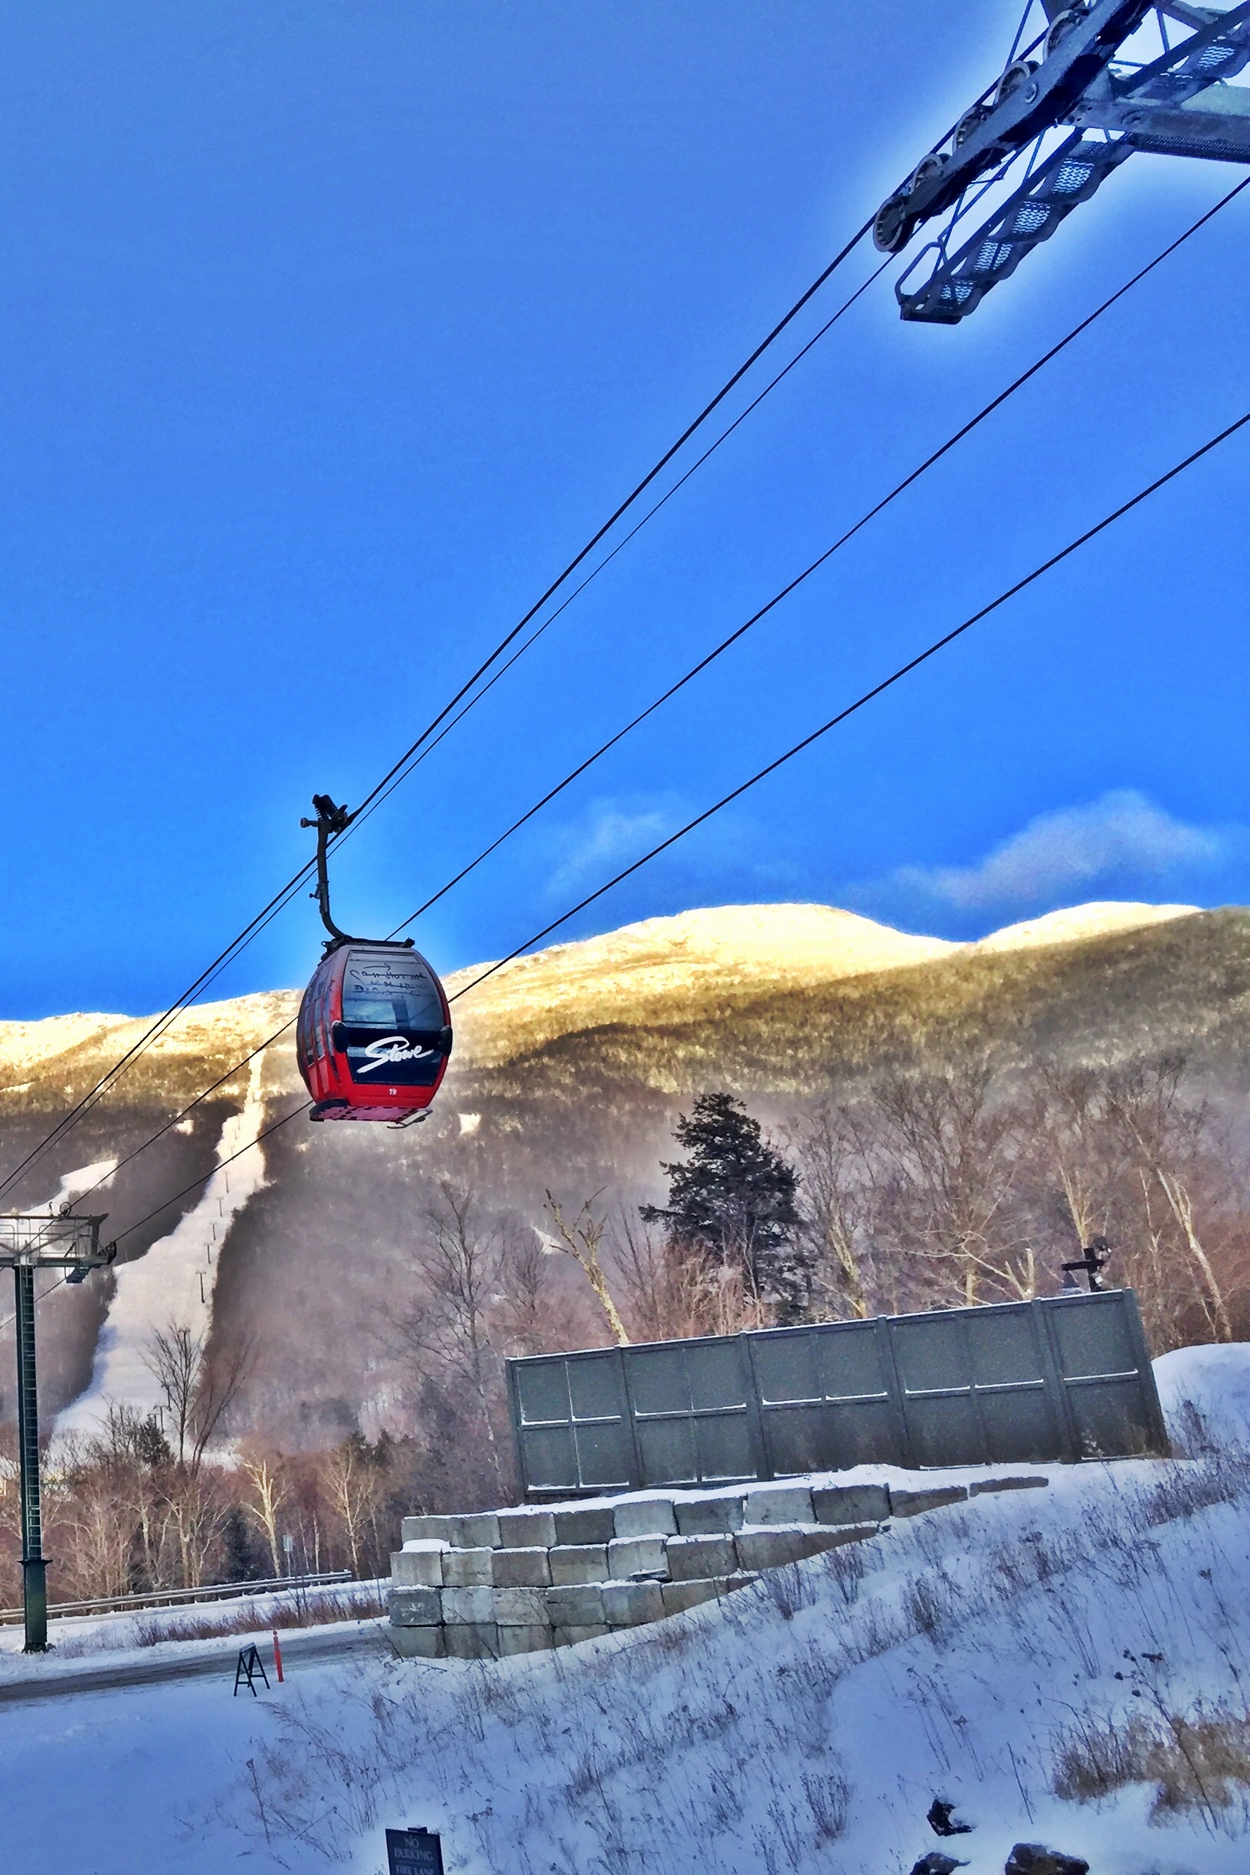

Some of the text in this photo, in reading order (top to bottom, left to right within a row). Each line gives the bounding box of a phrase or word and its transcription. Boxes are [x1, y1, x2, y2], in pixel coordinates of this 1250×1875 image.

[356, 1036, 434, 1073] Stowe
[404, 1835, 420, 1849] NO
[394, 1847, 434, 1862] PARKING
